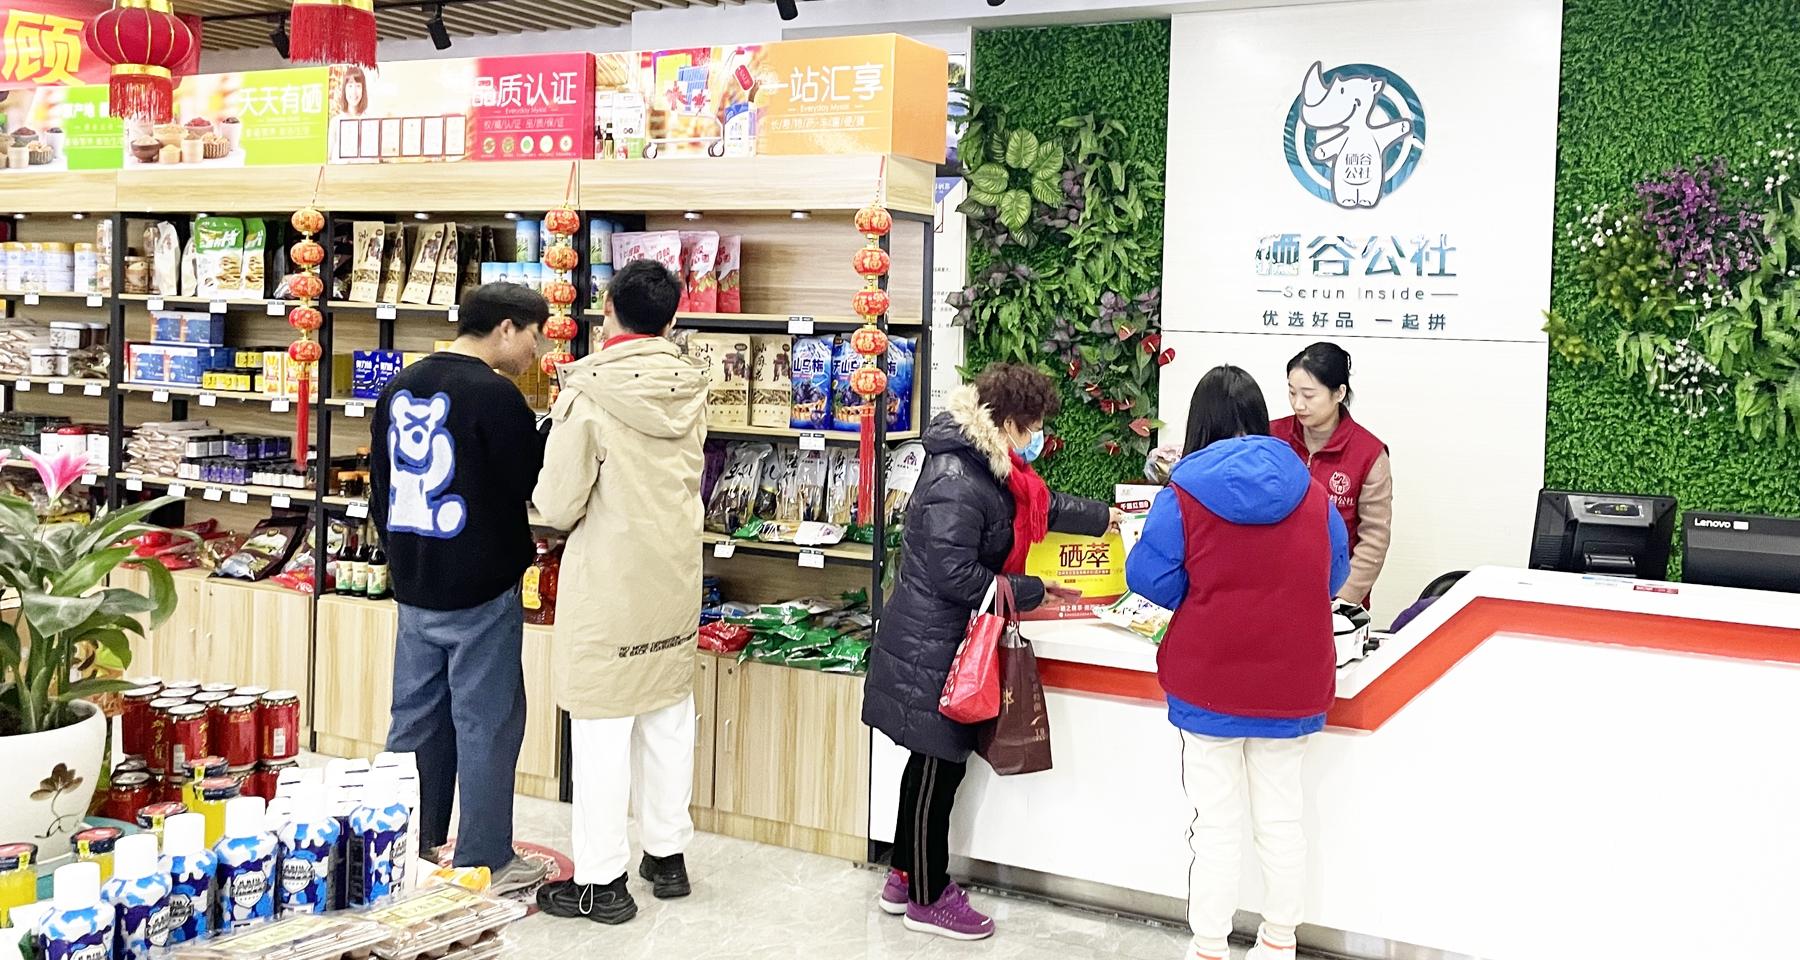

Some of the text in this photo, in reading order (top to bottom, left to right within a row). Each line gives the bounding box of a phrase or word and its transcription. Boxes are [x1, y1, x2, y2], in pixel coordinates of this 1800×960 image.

[2, 9, 86, 85] 顾
[472, 72, 578, 107] 品质认证
[760, 62, 884, 103] 一站汇享
[238, 84, 323, 117] 天天有硒
[1345, 167, 1371, 179] 公社
[1255, 233, 1457, 277] 硒谷公社
[1358, 287, 1425, 300] Inside
[1262, 310, 1447, 331] 优选好品 一起拼
[1694, 517, 1731, 529] Lenovo
[1059, 543, 1110, 568] 硒萃
